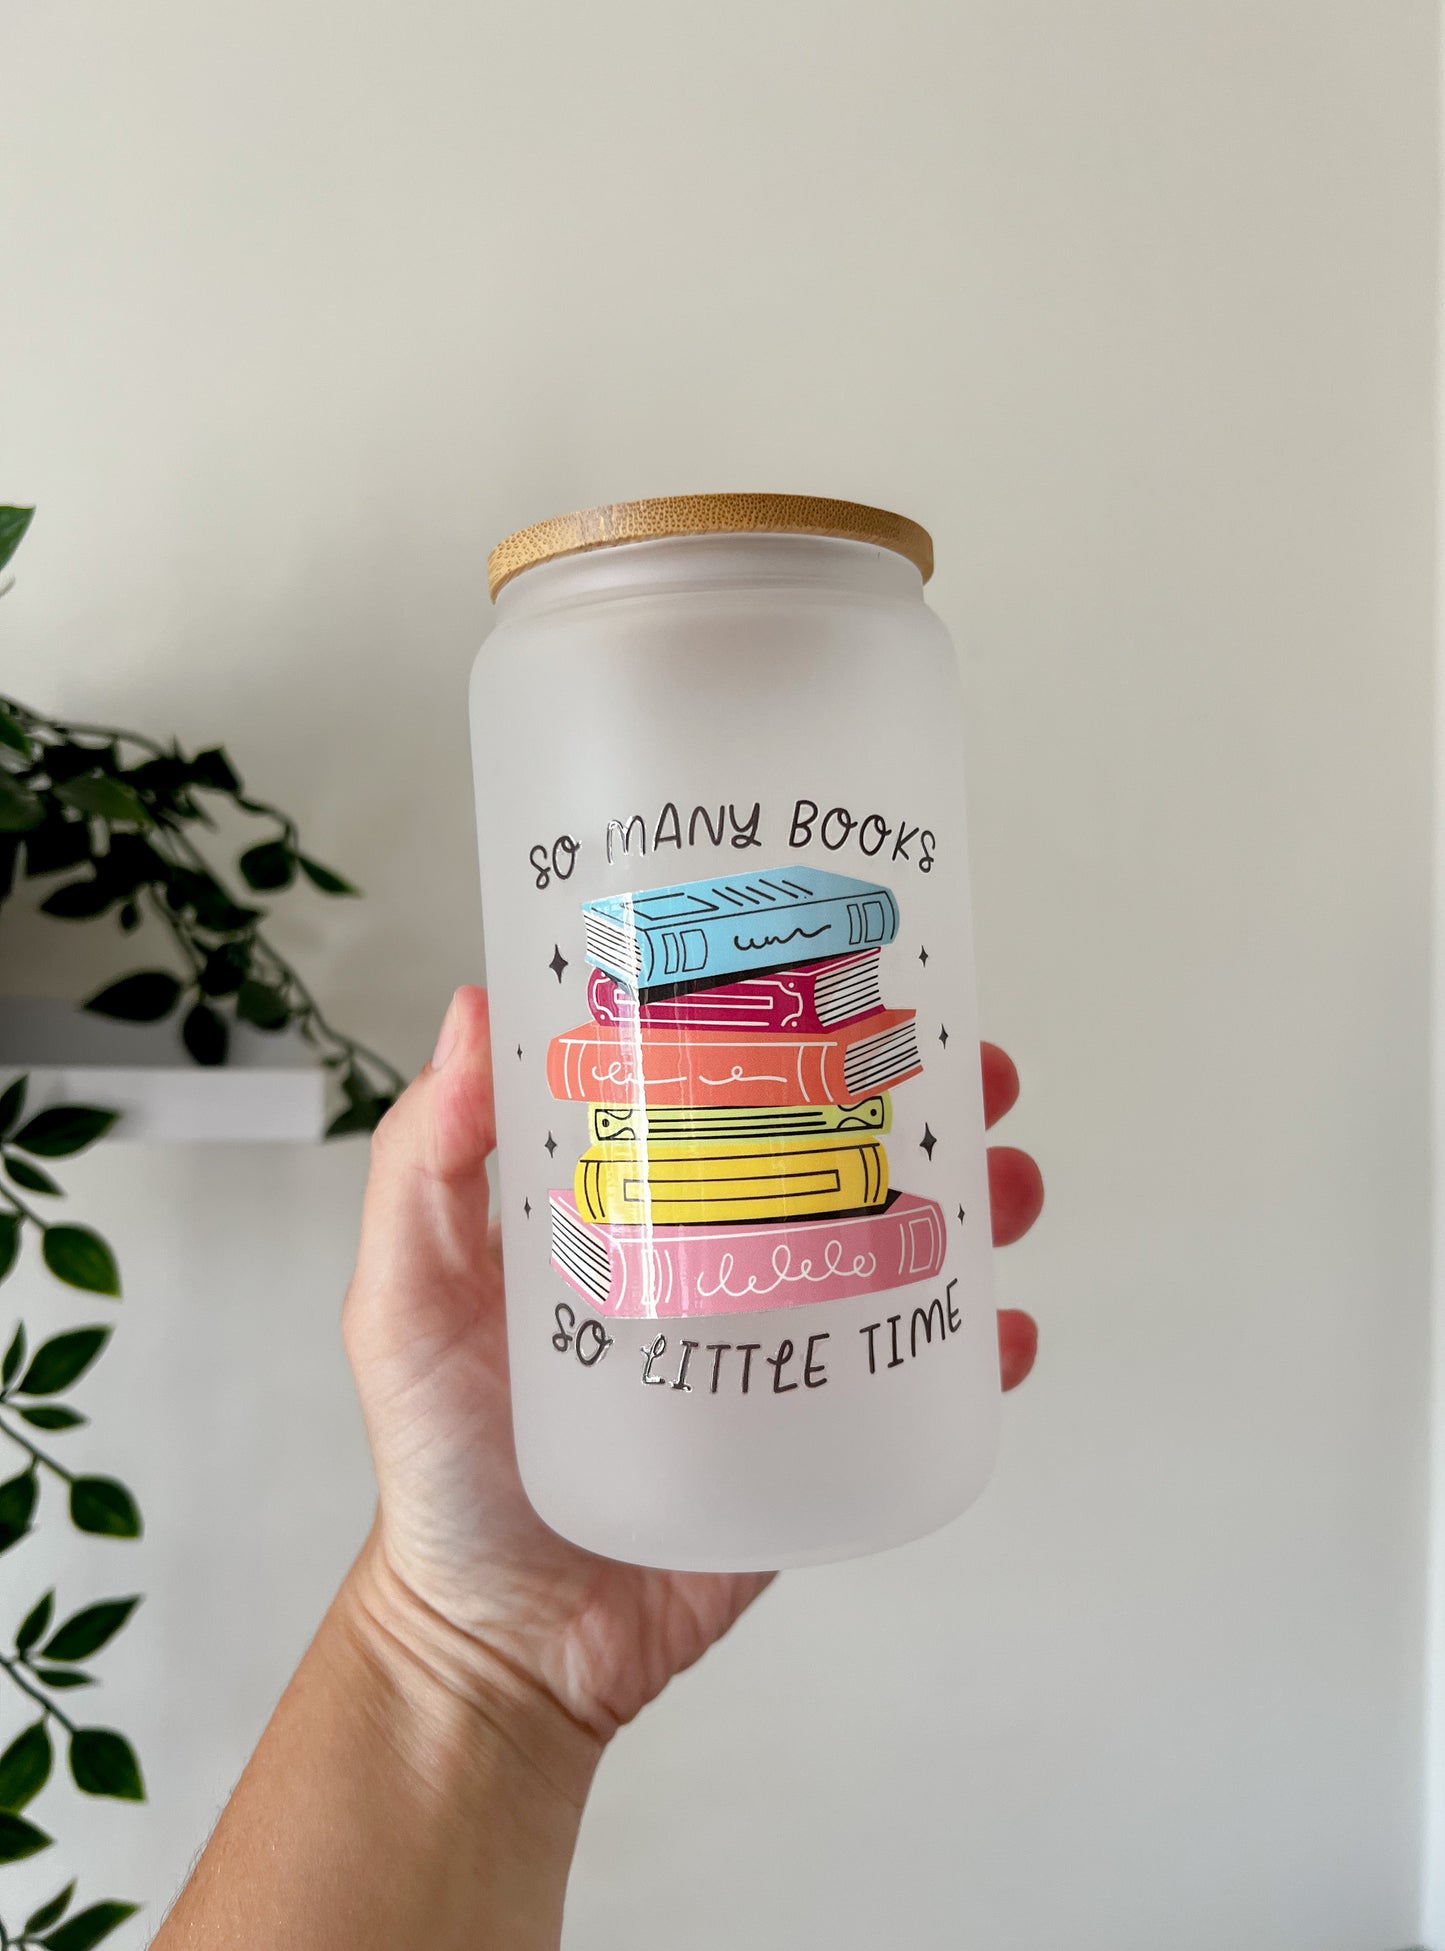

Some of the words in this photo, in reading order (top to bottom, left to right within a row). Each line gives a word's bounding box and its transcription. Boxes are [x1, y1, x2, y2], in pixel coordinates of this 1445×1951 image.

[529, 835, 582, 890] SO
[606, 802, 761, 864] MANY
[788, 799, 936, 873] BOOKS
[551, 1302, 615, 1366] SO
[640, 1333, 831, 1394] LITTLE
[859, 1277, 963, 1374] TIME
